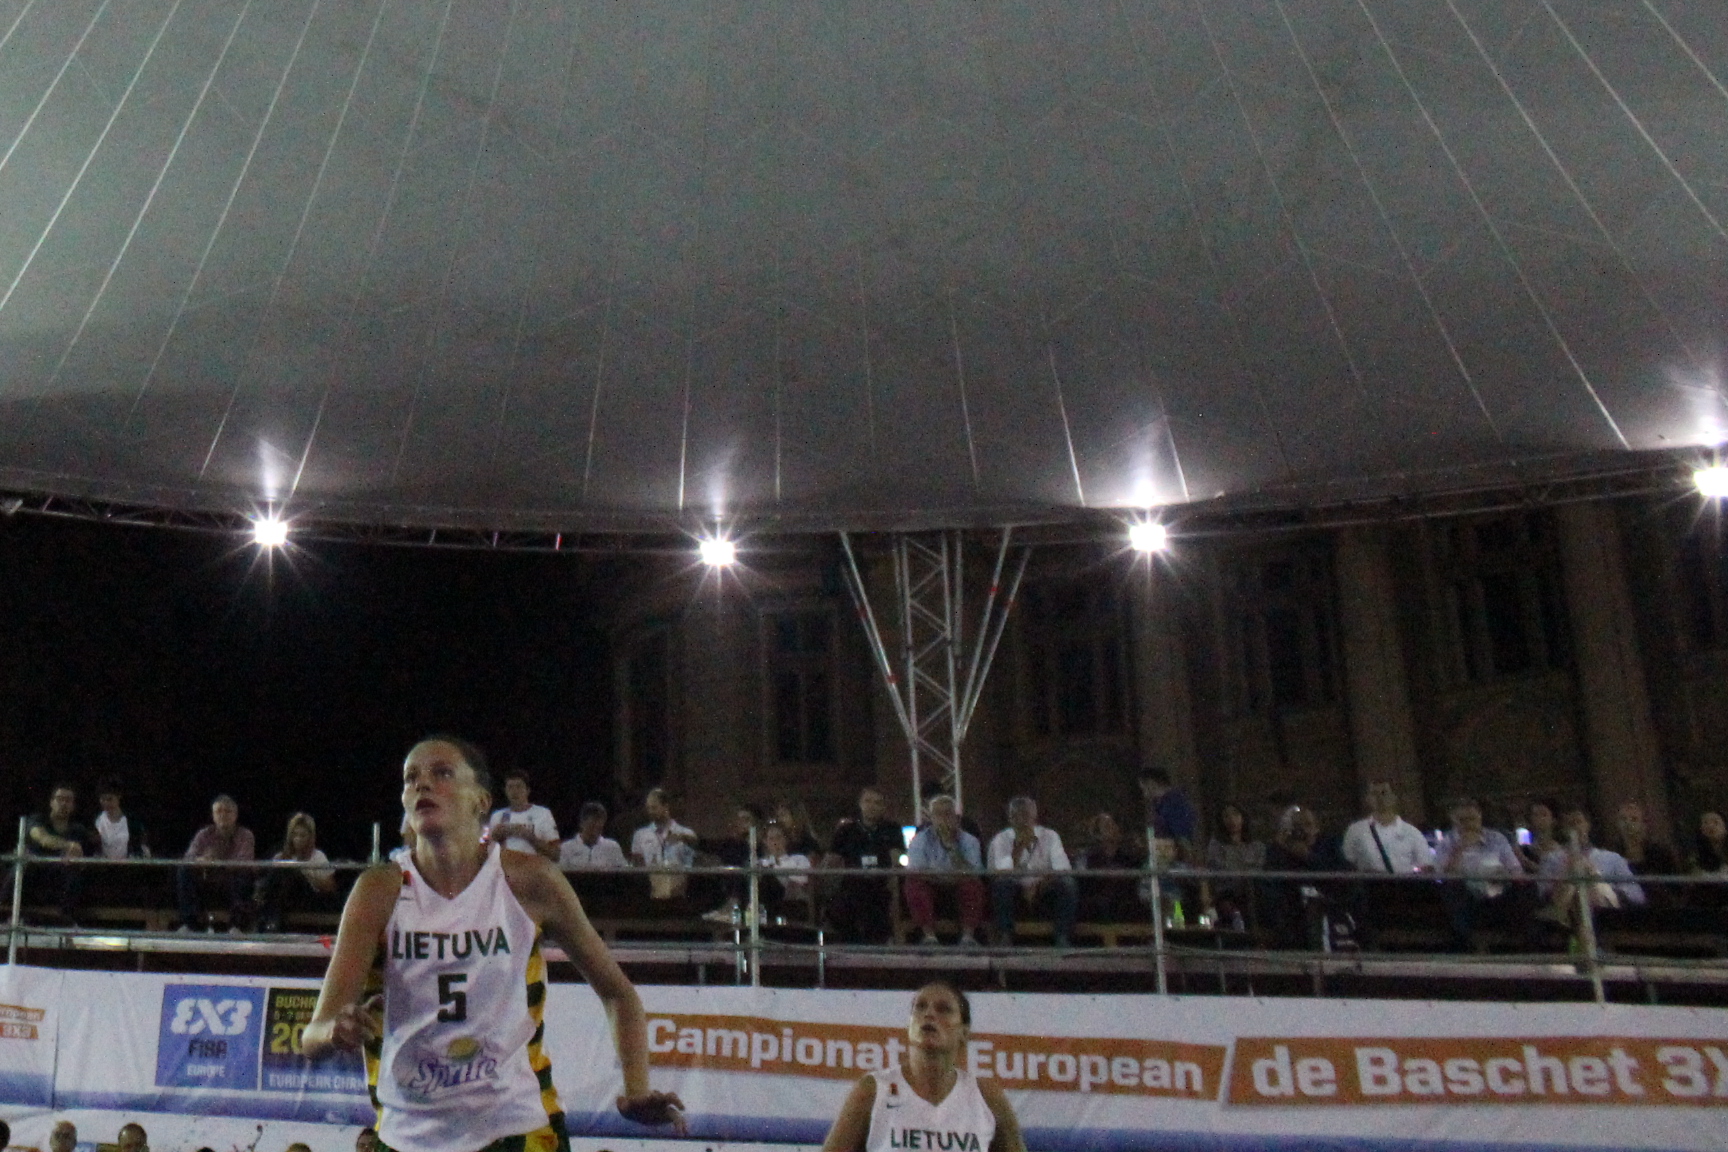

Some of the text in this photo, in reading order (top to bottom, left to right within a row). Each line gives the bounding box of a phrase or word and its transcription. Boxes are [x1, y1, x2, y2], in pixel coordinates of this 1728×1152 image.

[391, 926, 511, 960] LIETUVA
[437, 973, 468, 1022] 5
[187, 1039, 228, 1060] FIBA
[967, 1040, 1203, 1093] European
[186, 1064, 226, 1078] EUROPE
[1251, 1045, 1337, 1097] de
[1354, 1045, 1645, 1097] Baschet
[890, 1128, 982, 1152] LIETUVA
